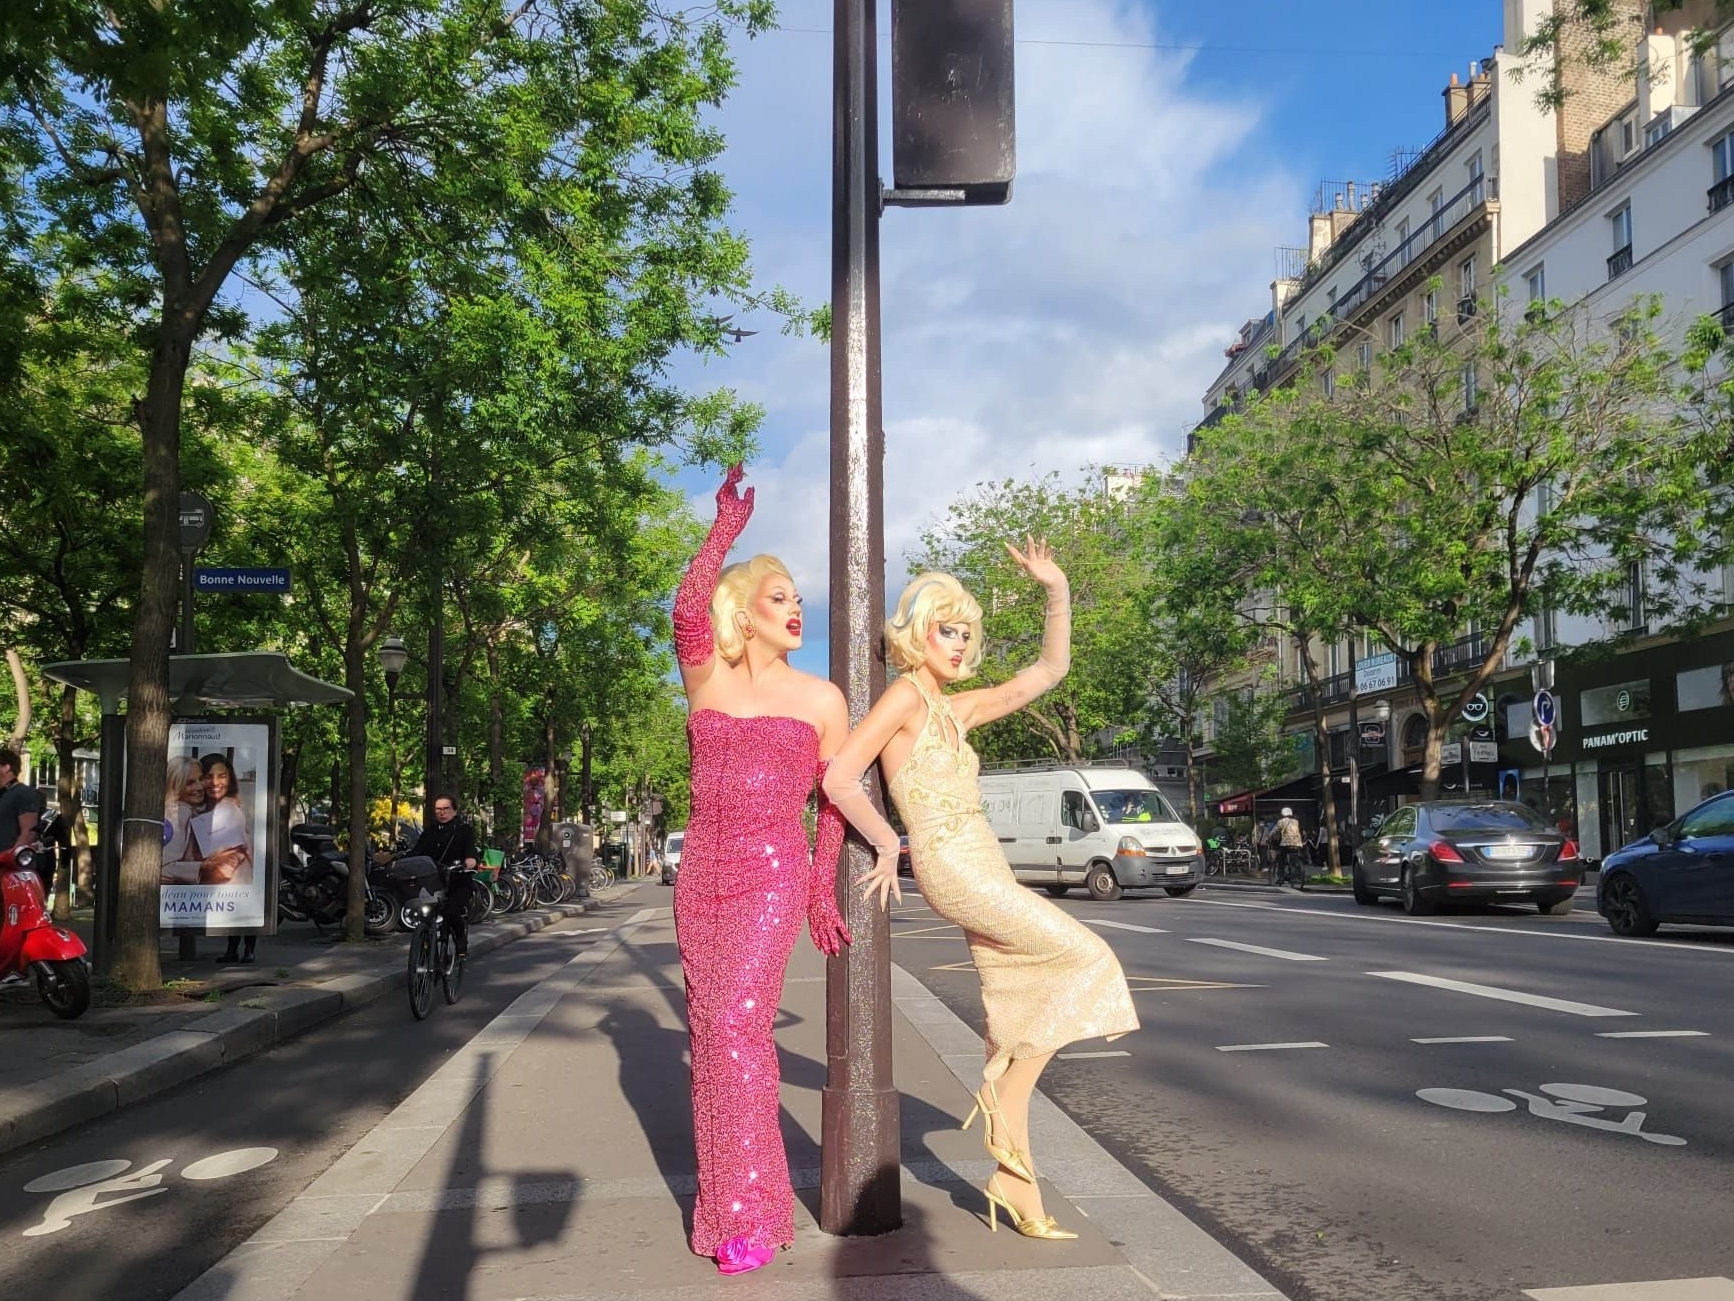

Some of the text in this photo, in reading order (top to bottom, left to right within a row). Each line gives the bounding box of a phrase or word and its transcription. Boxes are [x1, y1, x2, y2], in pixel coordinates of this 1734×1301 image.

[199, 574, 285, 585] Bonne Nouvelle
[1582, 729, 1649, 749] PANAM'OPTIC
[189, 891, 215, 901] pour
[217, 889, 250, 899] toutes
[164, 901, 235, 913] MAMANS
